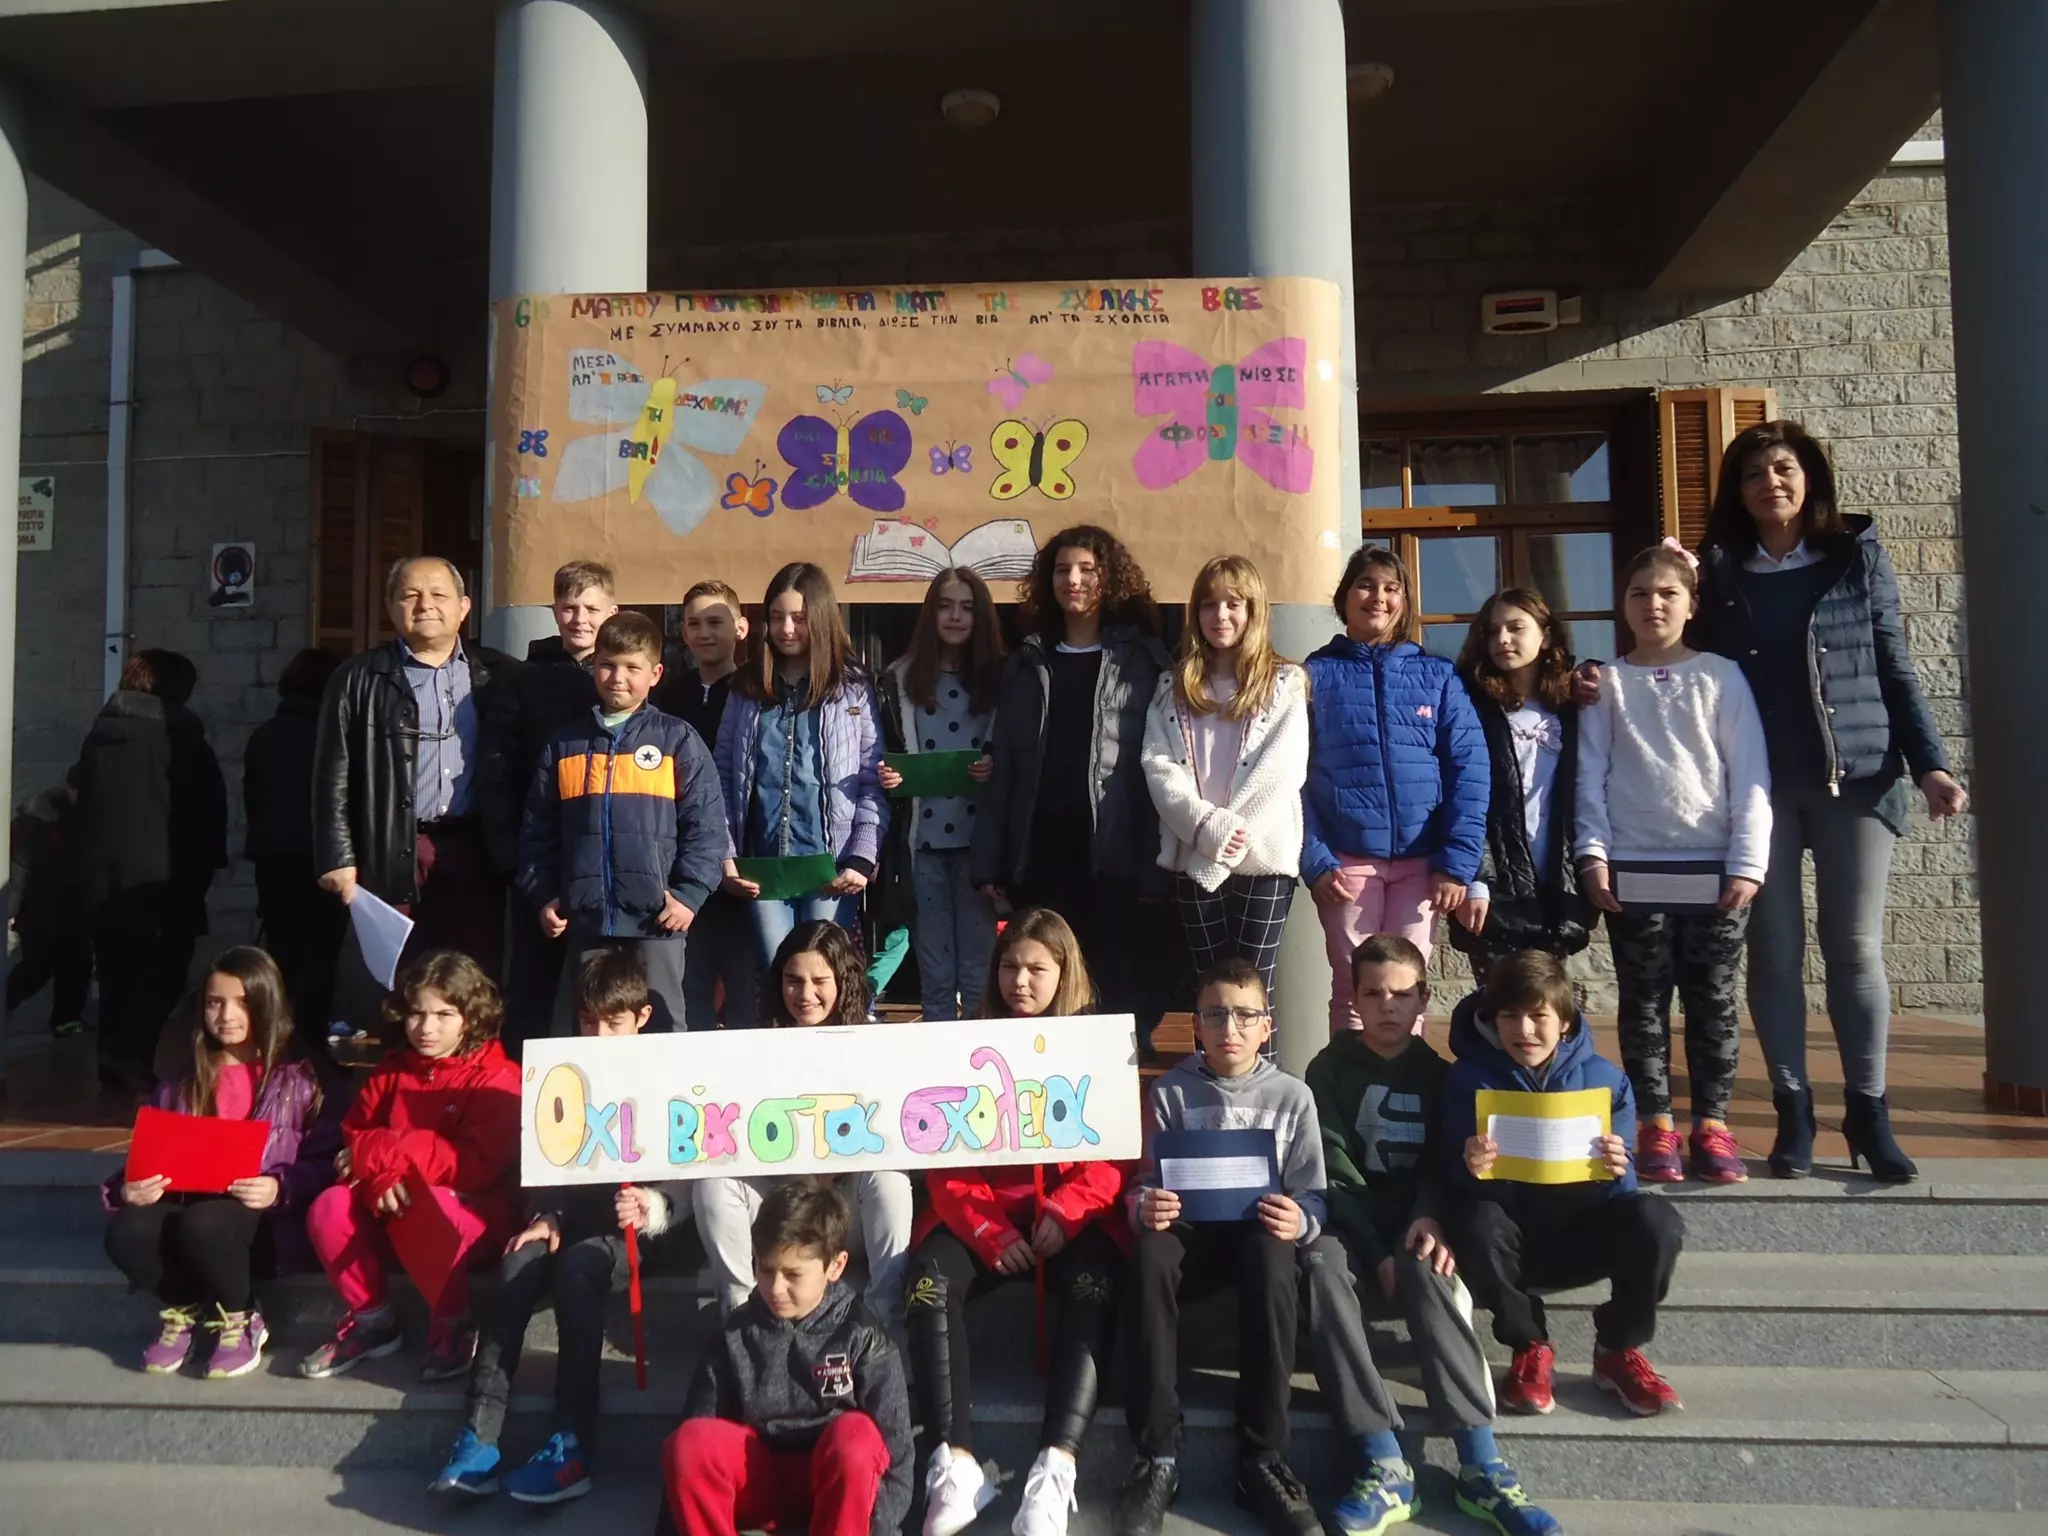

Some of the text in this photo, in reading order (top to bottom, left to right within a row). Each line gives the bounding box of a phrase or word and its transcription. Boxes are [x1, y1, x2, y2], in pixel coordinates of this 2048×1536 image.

[570, 294, 661, 319] ΜΑΡΤΙΟΥ
[1057, 287, 1164, 313] ΣΧΟΛΙΚΗΣ
[1201, 286, 1263, 312] ΒΙΑΣ
[610, 326, 634, 341] ΜΕ
[649, 320, 741, 338] ΣΥΜΜΑΧΟ
[751, 319, 778, 332] ΣΟΥ
[784, 320, 803, 330] ΤΑ
[879, 316, 919, 328] ΔΙΩΞΕ
[931, 314, 958, 326] ΤΗΝ
[976, 314, 999, 325] ΒΙΑ
[1029, 311, 1053, 325] ΑΠ'
[1060, 313, 1081, 324] ΤΑ
[1095, 313, 1170, 326] ΣΧΟΛΕΙΑ
[573, 355, 617, 370] ΜΕΣΑ
[1139, 367, 1297, 387] ΑΓΑΠΗ ΝΙΩΣΕ
[648, 407, 664, 422] ΤΗ
[748, 1093, 884, 1160] στα
